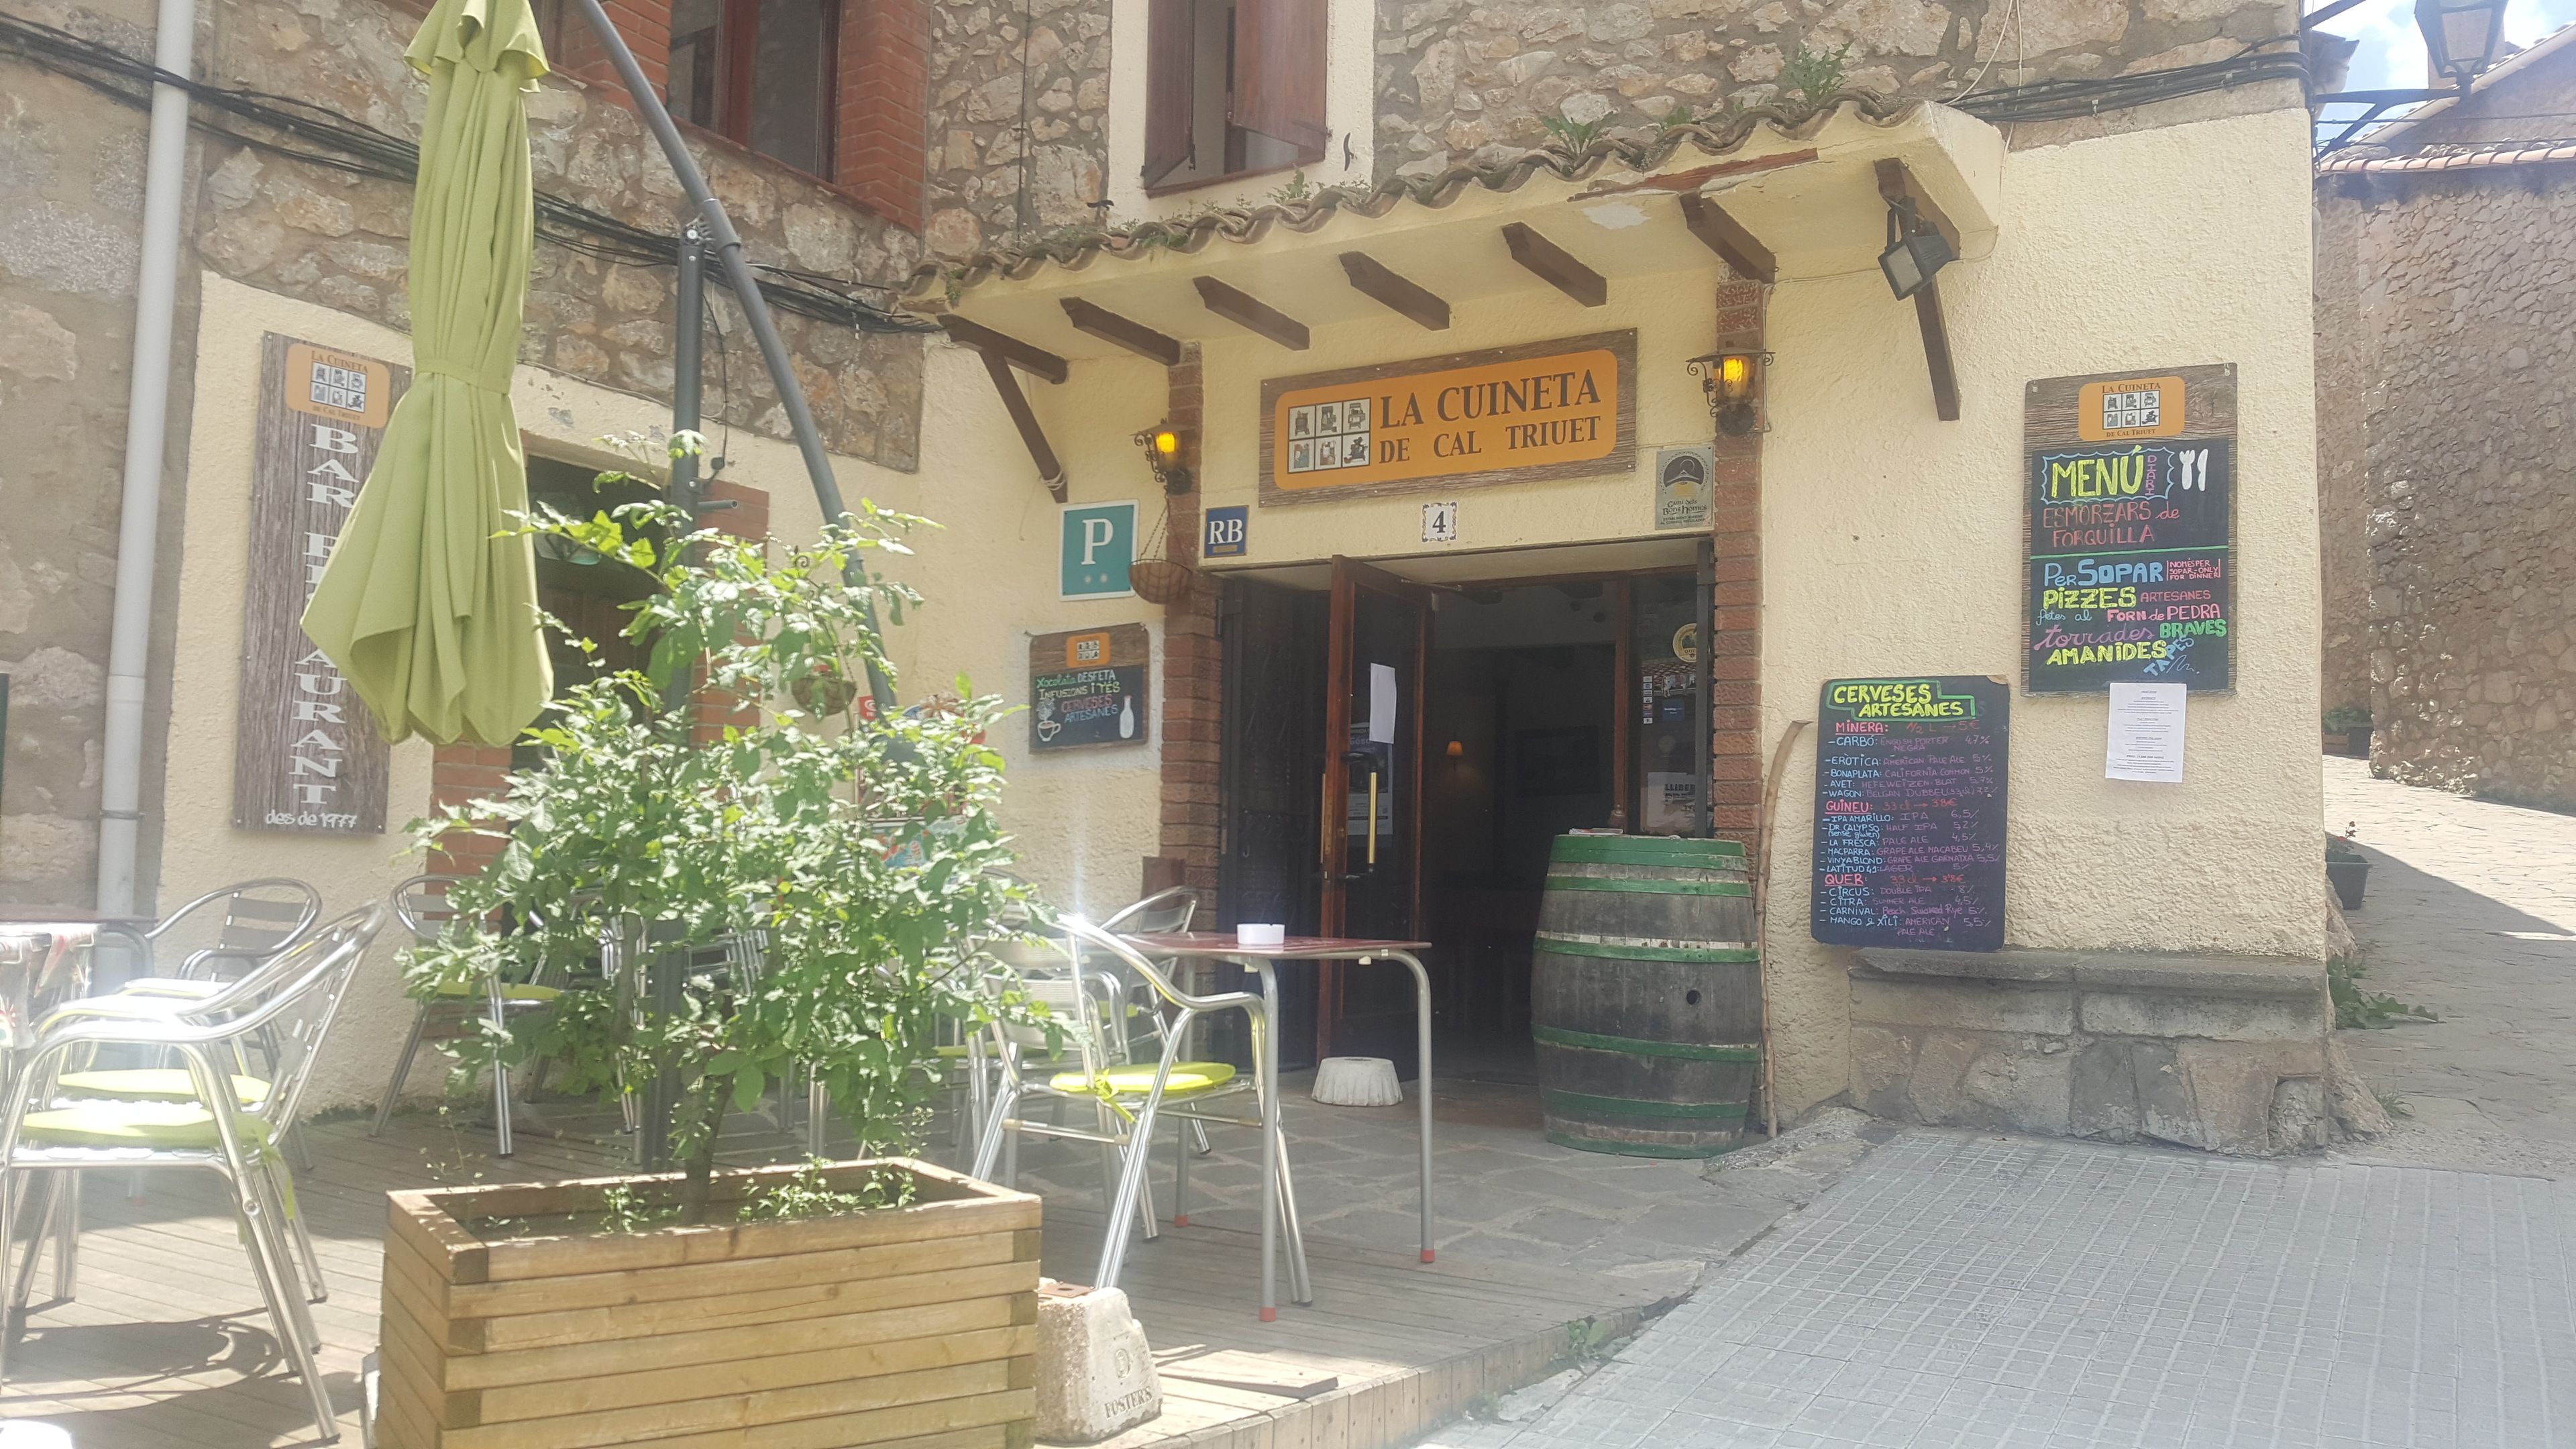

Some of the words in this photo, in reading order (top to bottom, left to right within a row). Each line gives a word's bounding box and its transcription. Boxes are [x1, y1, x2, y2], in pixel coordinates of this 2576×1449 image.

[1380, 392, 1425, 429] LA
[1437, 369, 1602, 422] CUINETA
[1379, 437, 1410, 464] DE
[1434, 431, 1482, 458] CAL
[1505, 415, 1602, 450] TRIUET
[306, 423, 360, 508] BAR
[2051, 444, 2144, 498] MENÚ
[2145, 455, 2157, 496] DIARI
[1432, 511, 1446, 534] 4
[2043, 501, 2151, 528] ESMORZARS
[2155, 500, 2180, 519] de
[1081, 518, 1114, 565] P
[1208, 519, 1243, 545] RB
[2078, 559, 2163, 586] SOPAR
[2140, 590, 2212, 602] ARTESANES
[2036, 609, 2066, 626] fetes
[2074, 609, 2092, 621] al
[2107, 608, 2147, 623] FORN
[2147, 608, 2165, 621] de
[2167, 603, 2221, 621] PEDRA
[2033, 623, 2155, 651] torrades
[2159, 619, 2227, 638] BRAVES
[2143, 637, 2194, 676] TAPES
[1036, 674, 1077, 688] Xocolata
[1077, 669, 1116, 682] DESFETA
[1038, 686, 1087, 698] INFUSIONS
[1834, 684, 1931, 704] CERVESES
[1061, 694, 1112, 712] CERVESES
[1858, 702, 1964, 718] ARTESANES
[1065, 704, 1118, 724] ARTESANES
[1928, 755, 1947, 764] PALE
[1949, 755, 1965, 763] ALE
[1831, 769, 1882, 778] BONAPLATA:
[1830, 780, 1856, 788] AVET:
[1828, 790, 1865, 798] WAGON:
[266, 809, 295, 826] des
[297, 810, 317, 826] de
[320, 812, 357, 828] 1977
[1900, 812, 1929, 820] IPA
[1915, 822, 1937, 830] IPA
[1842, 839, 1879, 847] FRESCA:
[1882, 837, 1907, 845] PALE
[1910, 835, 1929, 844] ALE
[1880, 864, 1913, 872] LAGER
[1890, 875, 1905, 884] 33
[1945, 904, 1963, 918] Rye
[1830, 916, 1862, 926] MANGO
[1897, 927, 1916, 936] PALE
[1919, 928, 1935, 936] ALE
